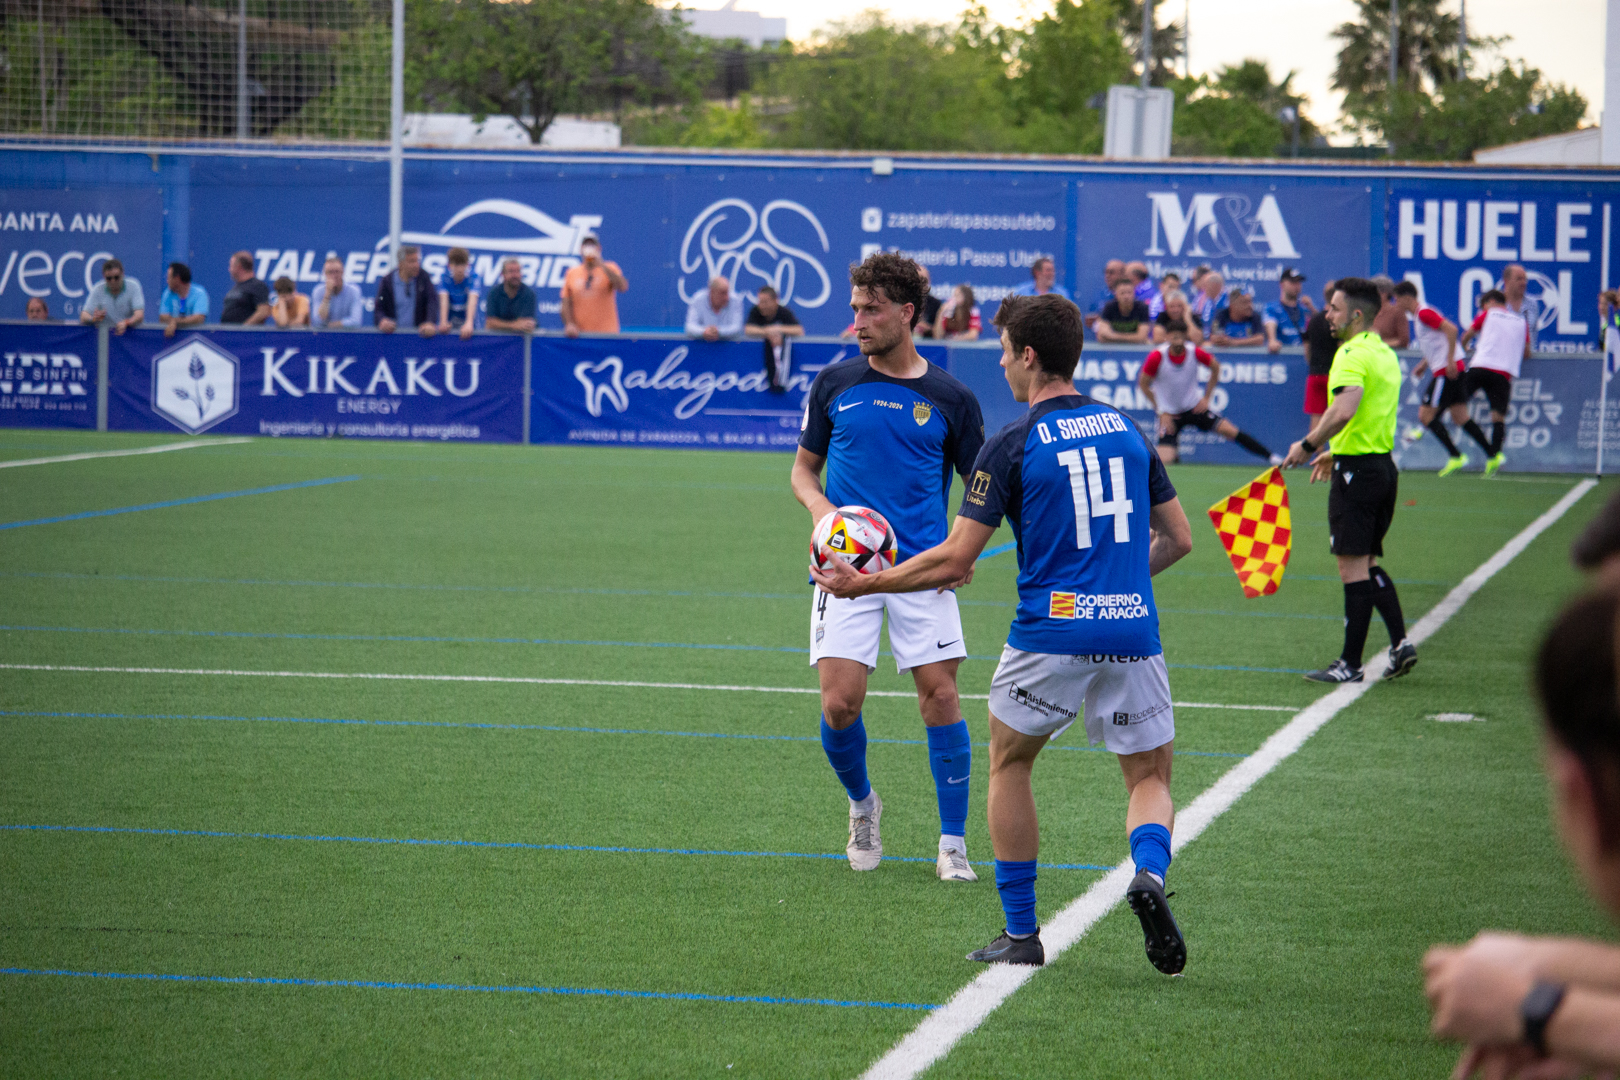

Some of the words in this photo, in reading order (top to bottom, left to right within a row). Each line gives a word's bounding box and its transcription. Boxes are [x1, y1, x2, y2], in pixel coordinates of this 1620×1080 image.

[0, 212, 65, 232] ANTA
[70, 213, 119, 233] ANA
[1144, 192, 1301, 259] M&A
[1398, 200, 1592, 262] HUELE
[260, 347, 482, 397] KIKAKU
[336, 398, 401, 414] ENERGY
[873, 399, 903, 411] 1924-2024
[1037, 422, 1058, 445] O.
[1056, 412, 1128, 440] SARRIEGI
[1056, 446, 1134, 550] 14
[1076, 593, 1142, 607] GOBIERNO
[1076, 606, 1094, 619] DE
[1098, 604, 1149, 620] ARAGON
[1027, 692, 1078, 719] Aislamientos
